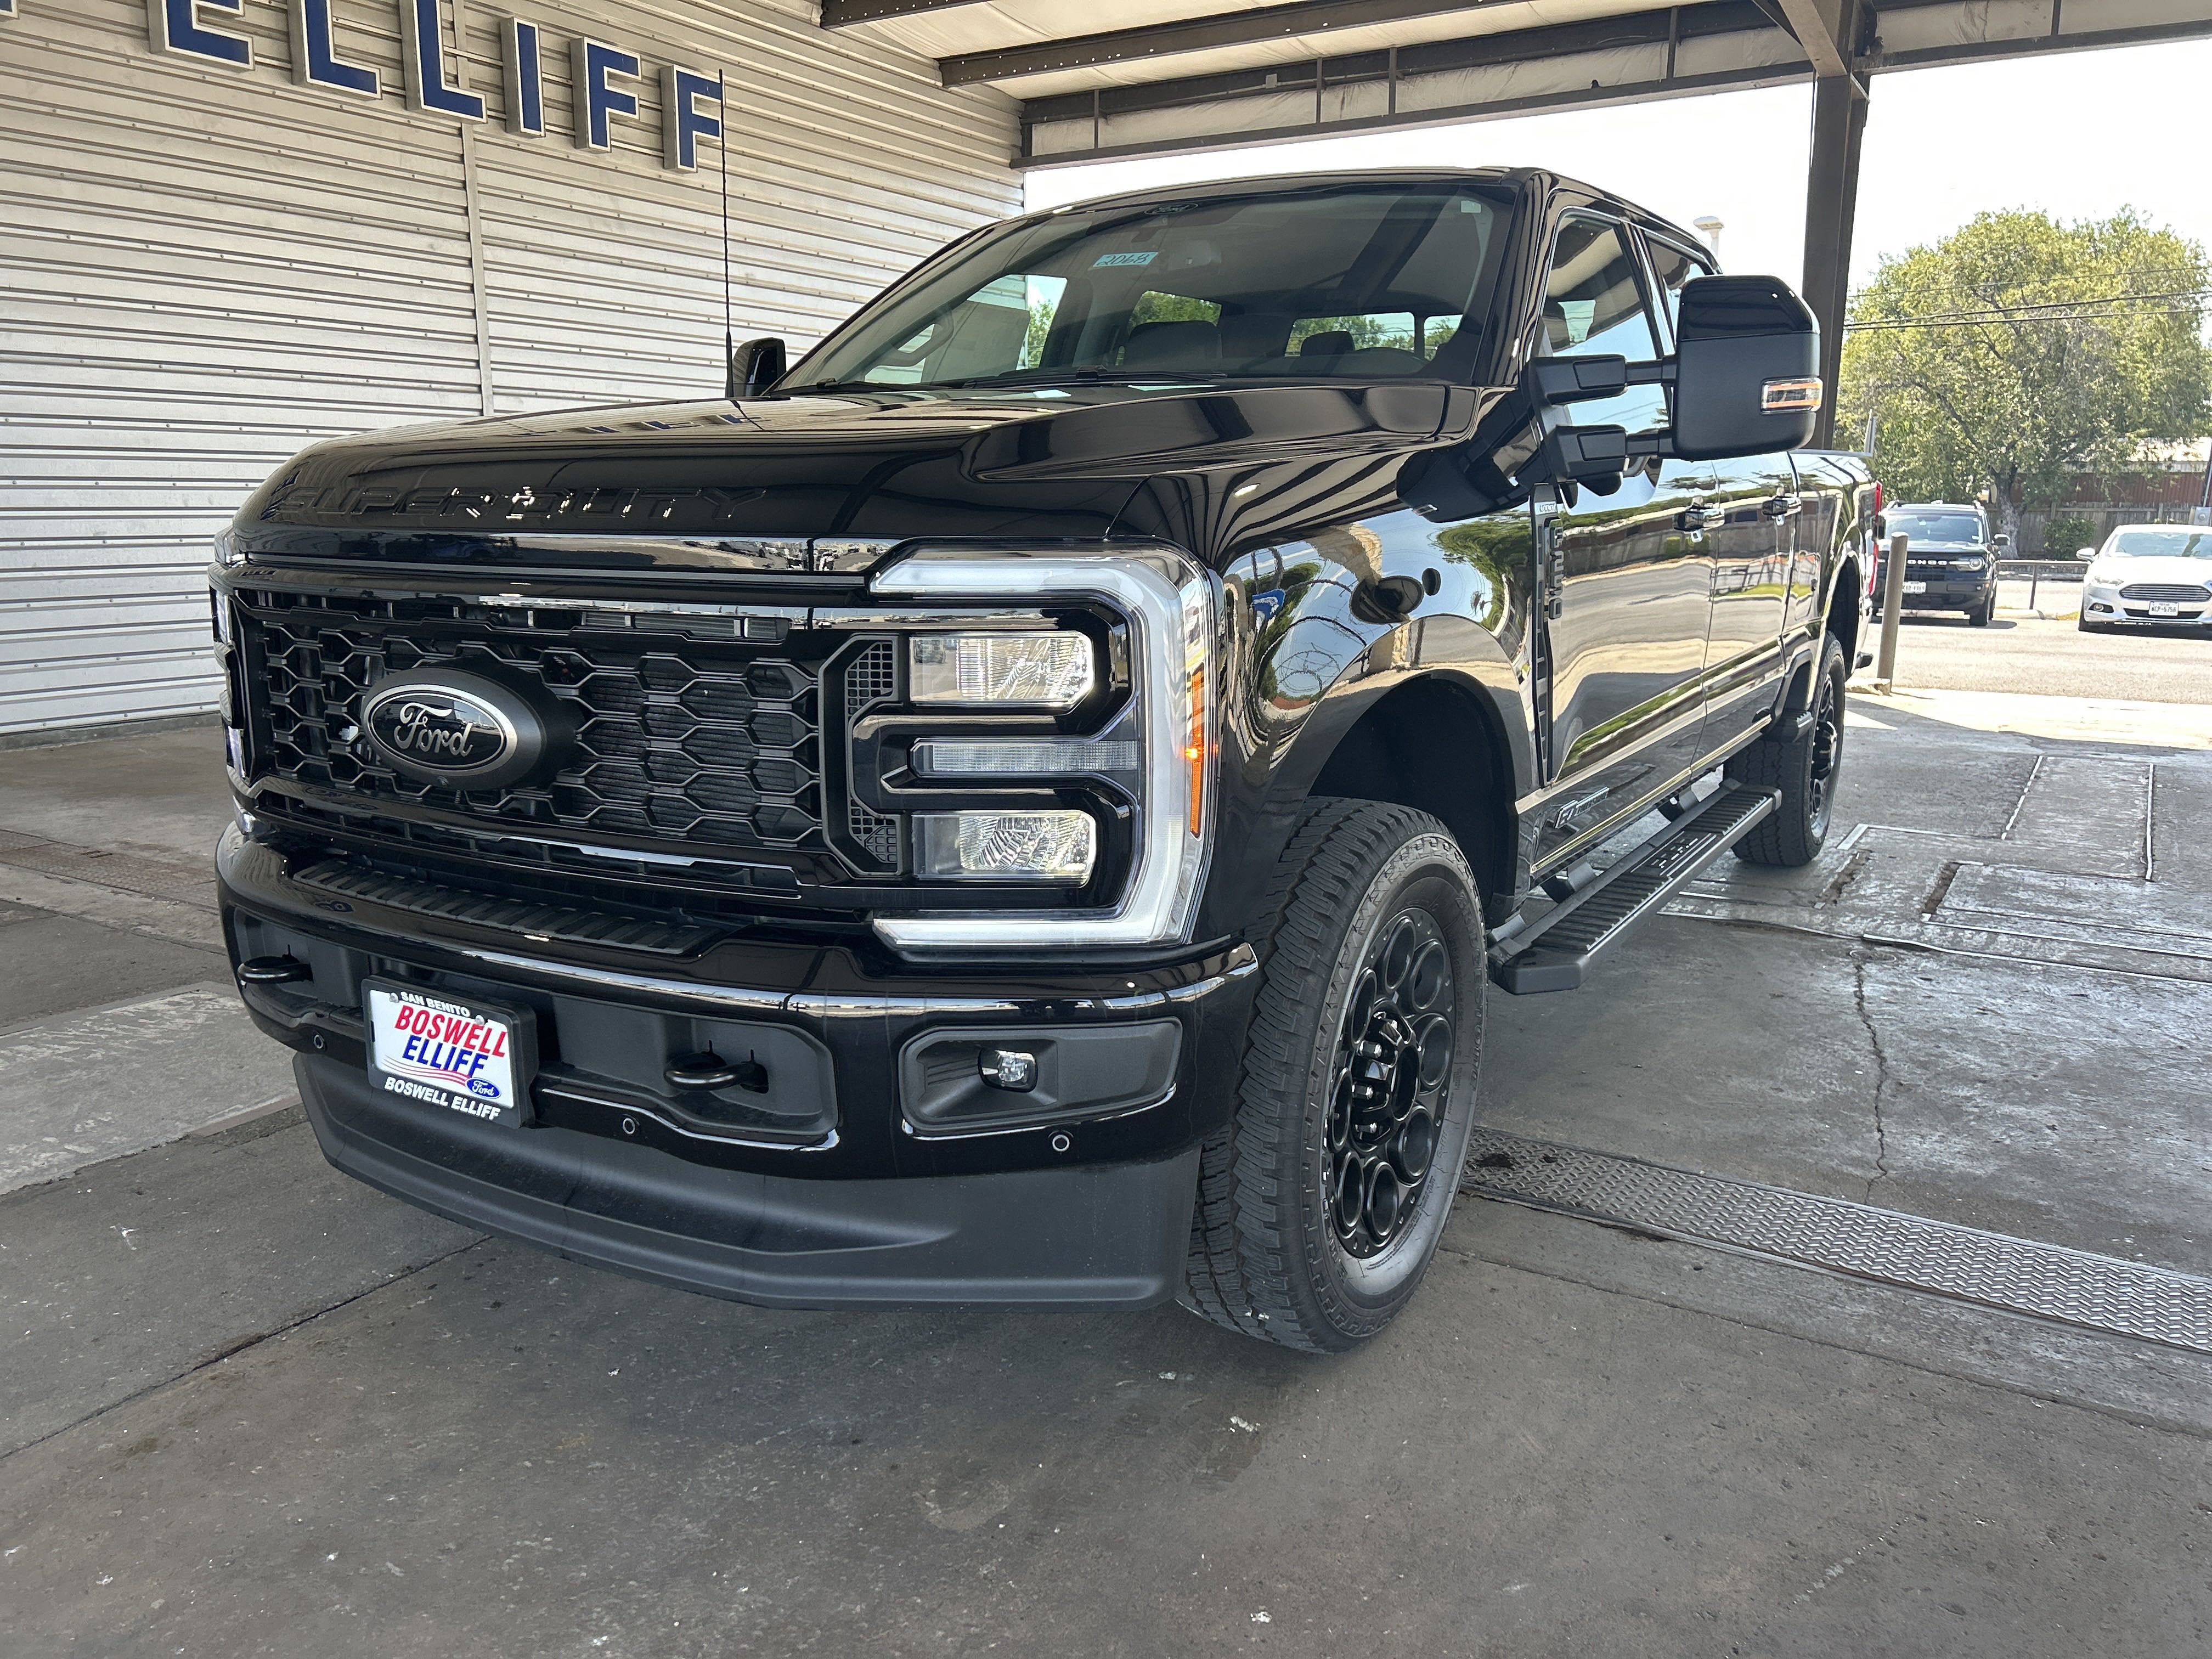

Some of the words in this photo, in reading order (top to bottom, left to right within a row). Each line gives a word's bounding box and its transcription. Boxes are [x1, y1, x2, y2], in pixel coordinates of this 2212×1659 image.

[1096, 253, 1150, 266] 2068
[276, 486, 500, 517] SUPER
[506, 487, 767, 520] DUTY
[393, 702, 473, 757] Ford
[400, 991, 424, 1006] SAN
[426, 997, 471, 1018] BENITO
[394, 1005, 508, 1058] BOSWELL
[402, 1034, 489, 1077] ELLIFF
[384, 1076, 449, 1106] BOSWELL
[450, 1096, 501, 1120] ELLIFF
[471, 1080, 495, 1097] Ford
